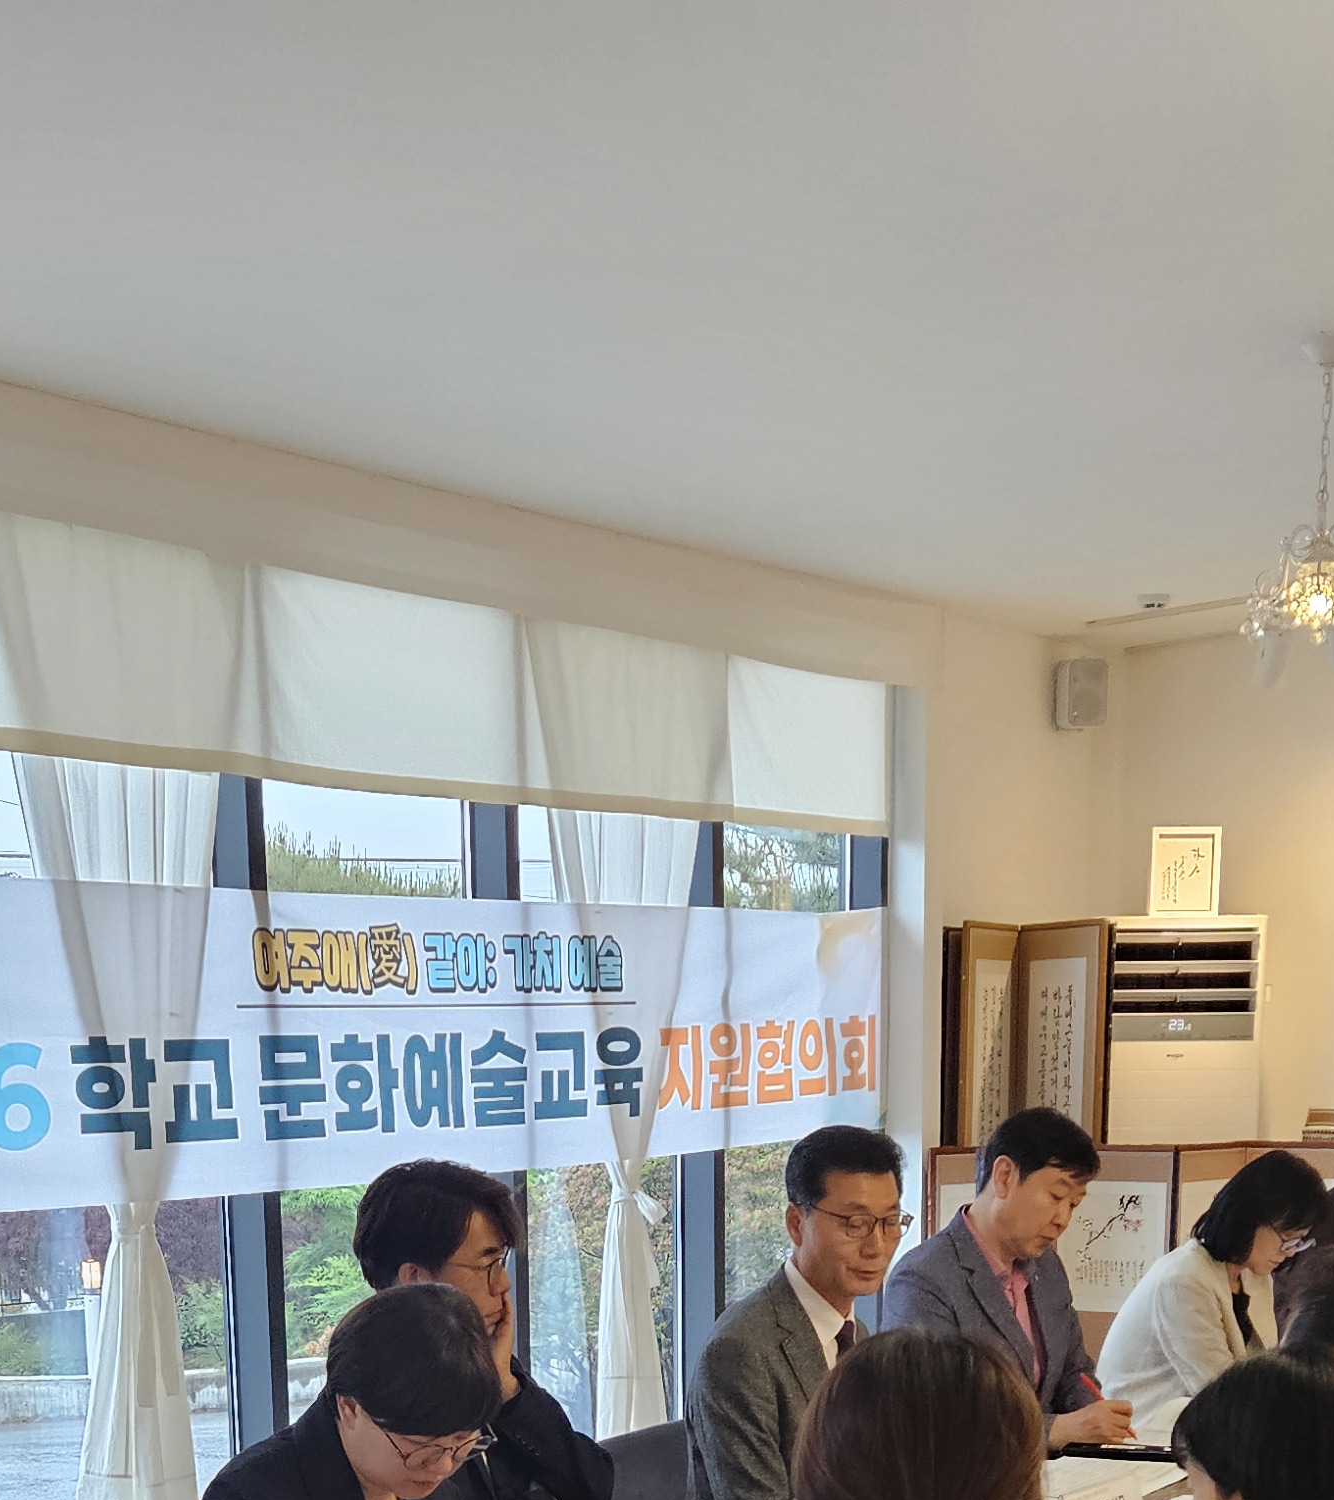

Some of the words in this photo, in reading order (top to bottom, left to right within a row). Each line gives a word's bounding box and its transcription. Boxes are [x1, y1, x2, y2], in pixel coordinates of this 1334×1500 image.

[252, 923, 418, 995] 여주애(愛)
[503, 931, 561, 993] 가치
[568, 935, 623, 993] 예술
[71, 1035, 240, 1150] 학교
[259, 1026, 644, 1142] 문화예술교육
[658, 1013, 878, 1112] 지원협의회
